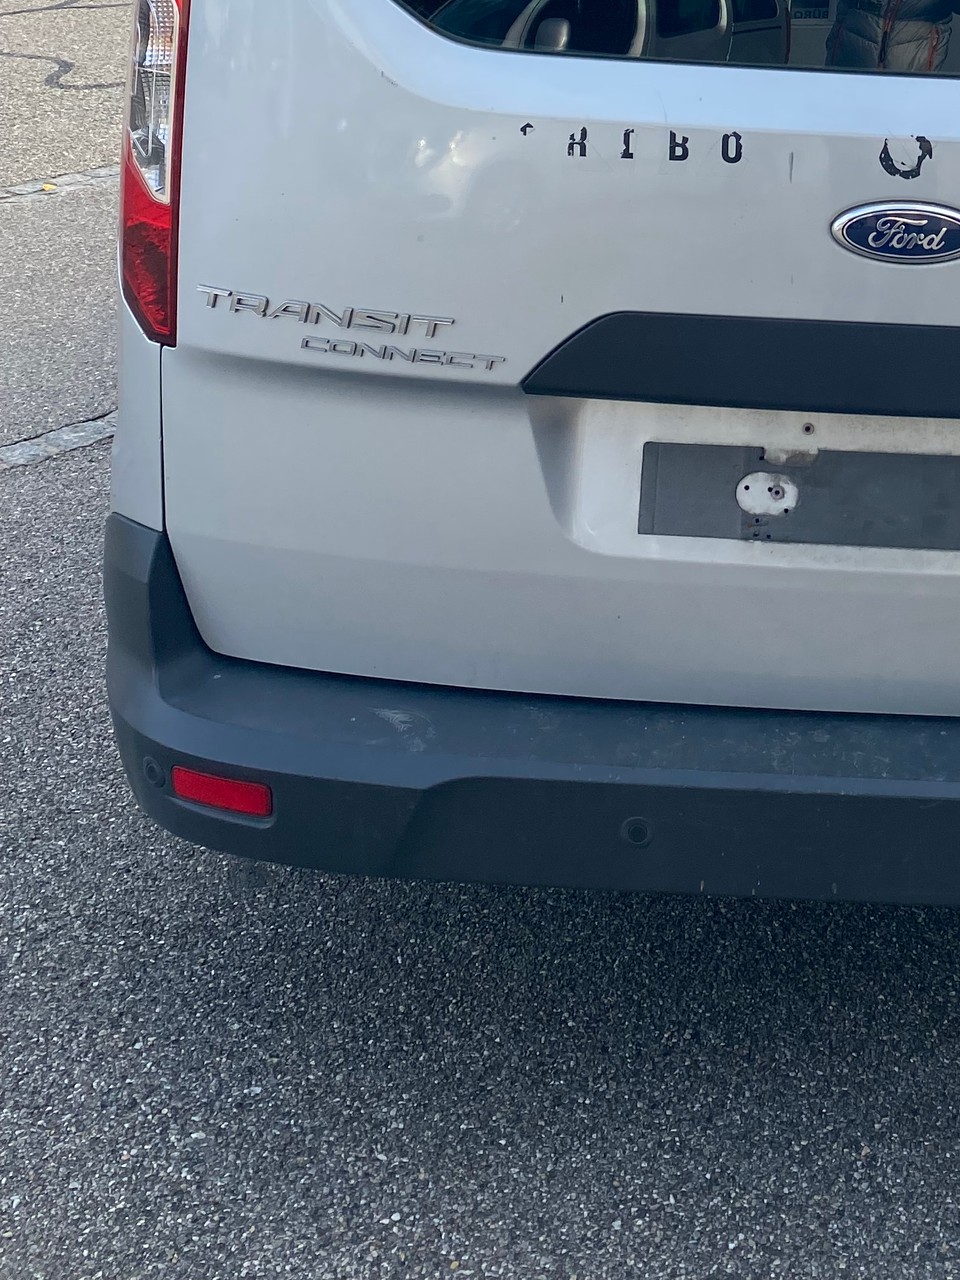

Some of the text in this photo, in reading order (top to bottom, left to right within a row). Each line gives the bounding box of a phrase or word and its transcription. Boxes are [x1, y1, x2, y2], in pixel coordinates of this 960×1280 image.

[867, 216, 947, 251] Ford
[196, 284, 455, 339] TRANSIT
[300, 335, 506, 371] CONNECT
